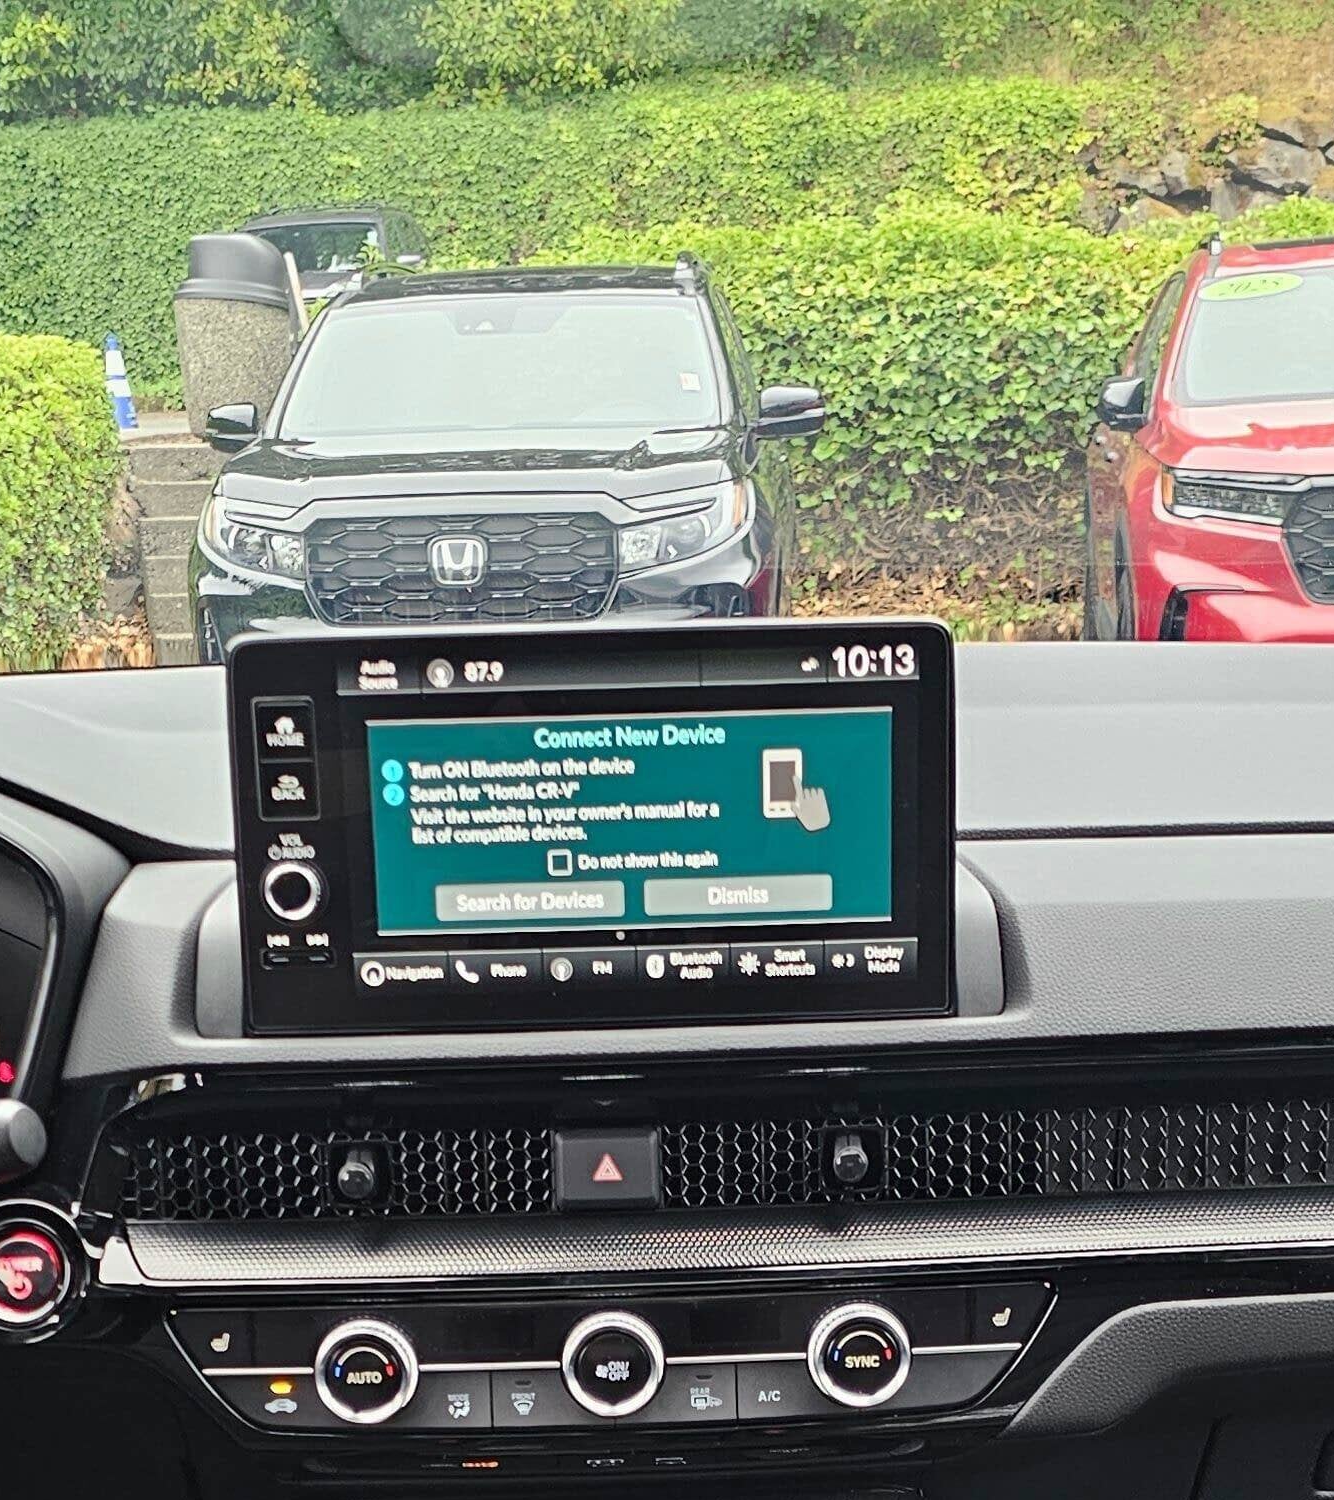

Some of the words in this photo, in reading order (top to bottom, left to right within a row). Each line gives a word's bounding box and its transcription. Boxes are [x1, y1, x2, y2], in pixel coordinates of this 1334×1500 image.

[359, 660, 396, 675] Audio
[831, 644, 915, 678] 10:13
[464, 661, 504, 682] 87.9
[358, 675, 398, 690] Source
[266, 732, 305, 747] HOME
[534, 727, 612, 749] Connect
[615, 726, 659, 747] New
[662, 724, 726, 745] Device
[408, 761, 443, 780] Turn
[443, 760, 470, 778] ON
[470, 758, 540, 777] Bluetooth
[541, 762, 563, 776] on
[563, 758, 586, 776] the
[588, 757, 635, 775] device
[271, 786, 306, 801] BACK
[409, 785, 457, 803] Search
[458, 784, 481, 801] for
[482, 782, 535, 800] "Honda
[535, 781, 580, 799] CR-V"
[410, 807, 443, 825] Visit
[443, 806, 470, 824] the
[470, 805, 526, 823] website
[527, 805, 542, 822] in
[542, 806, 577, 824] your
[578, 803, 632, 821] owner's
[634, 801, 685, 819] manual
[686, 800, 709, 818] for
[709, 805, 720, 819] a
[411, 827, 436, 844] list
[436, 826, 452, 843] of
[453, 825, 530, 845] compatible
[531, 824, 587, 842] devices.
[577, 854, 599, 870] Do
[600, 854, 623, 869] not
[624, 852, 658, 869] show
[659, 852, 684, 867] this
[684, 851, 718, 869] again
[456, 892, 511, 913] Search
[513, 891, 538, 911] for
[540, 890, 605, 911] Devices
[707, 886, 769, 905] Dismiss
[669, 951, 723, 966] Bluetooth
[773, 949, 806, 963] Smart
[864, 946, 904, 963] Display
[385, 964, 444, 981] Navigation
[490, 963, 527, 978] Phone
[679, 965, 713, 980] Audio
[765, 962, 816, 977] Shortcuts
[867, 959, 900, 974] Mode
[607, 1360, 630, 1371] ON/
[844, 1355, 880, 1369] SYNC
[346, 1371, 383, 1385] AUTO
[608, 1371, 630, 1382] OFF
[511, 1393, 536, 1401] FRONT
[758, 1390, 781, 1403] A/C
